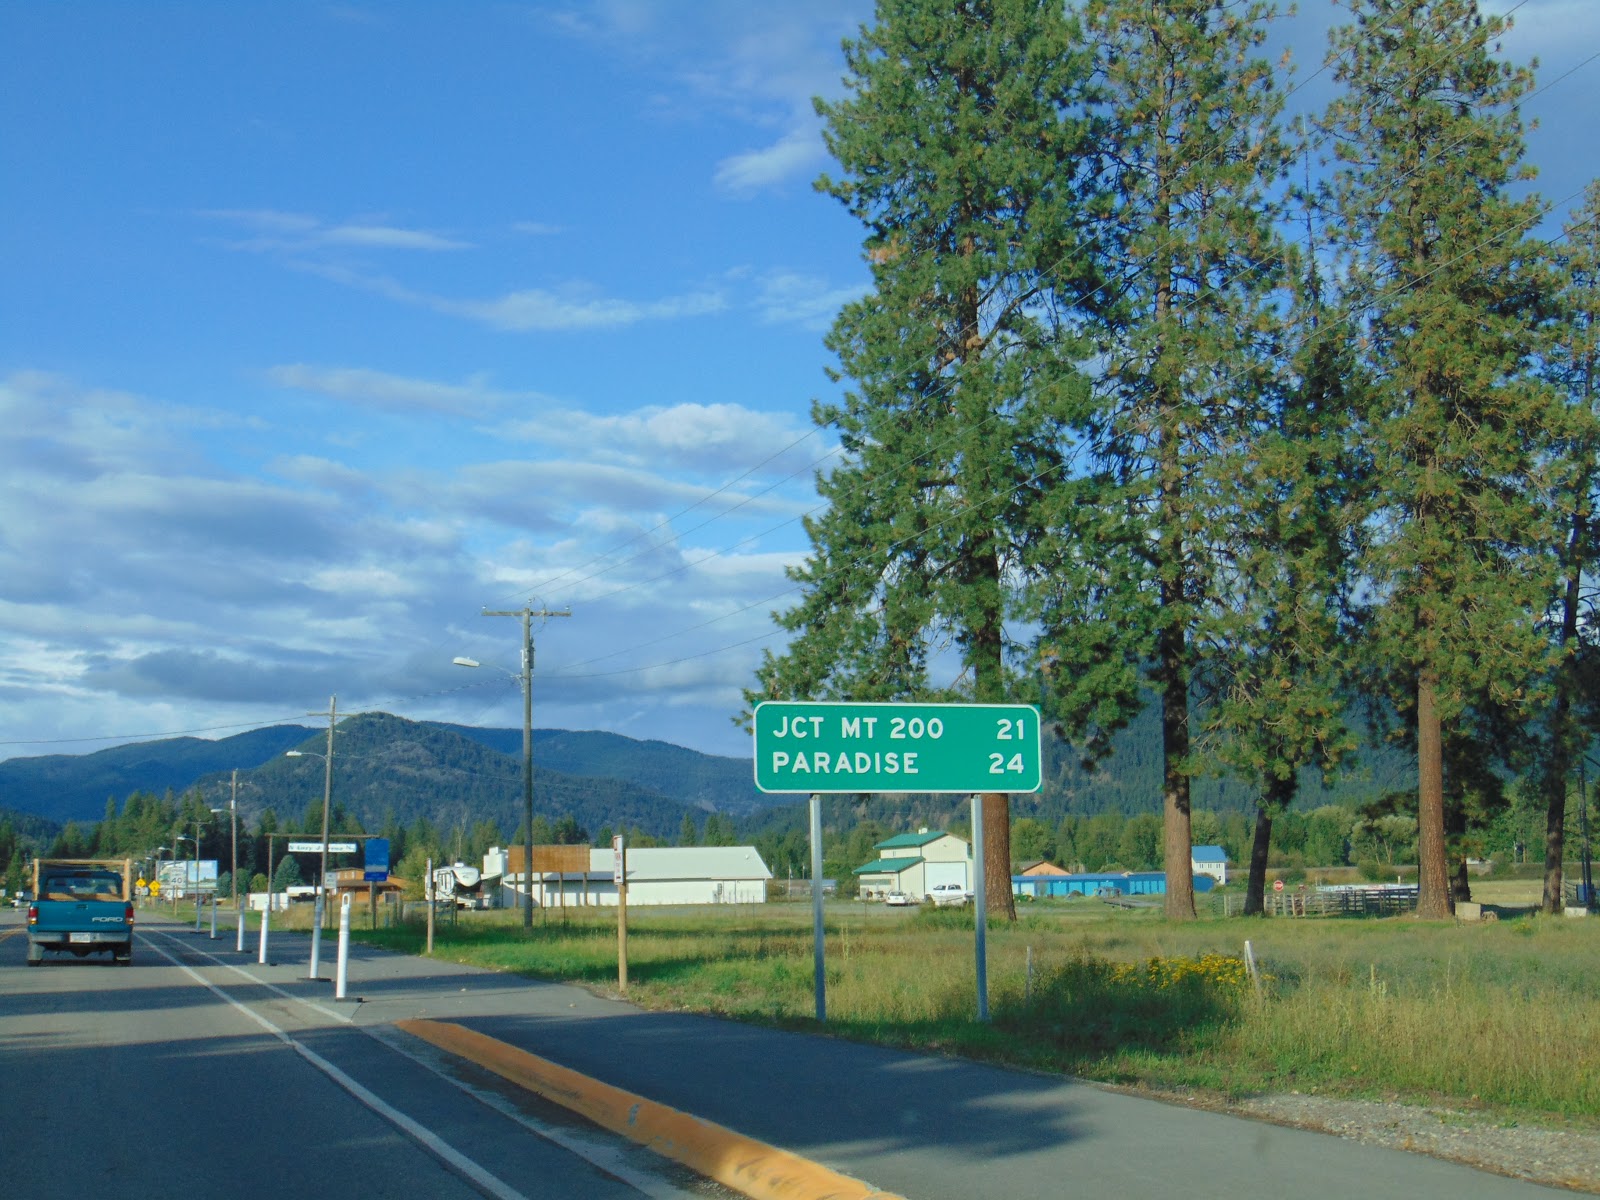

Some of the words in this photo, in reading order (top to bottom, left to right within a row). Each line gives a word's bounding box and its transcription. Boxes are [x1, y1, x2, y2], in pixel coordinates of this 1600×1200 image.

[773, 716, 825, 738] JCT
[841, 717, 878, 739] MT
[890, 717, 944, 739] 200
[996, 718, 1025, 740] 21
[772, 751, 919, 774] PARADISE
[988, 752, 1024, 774] 24
